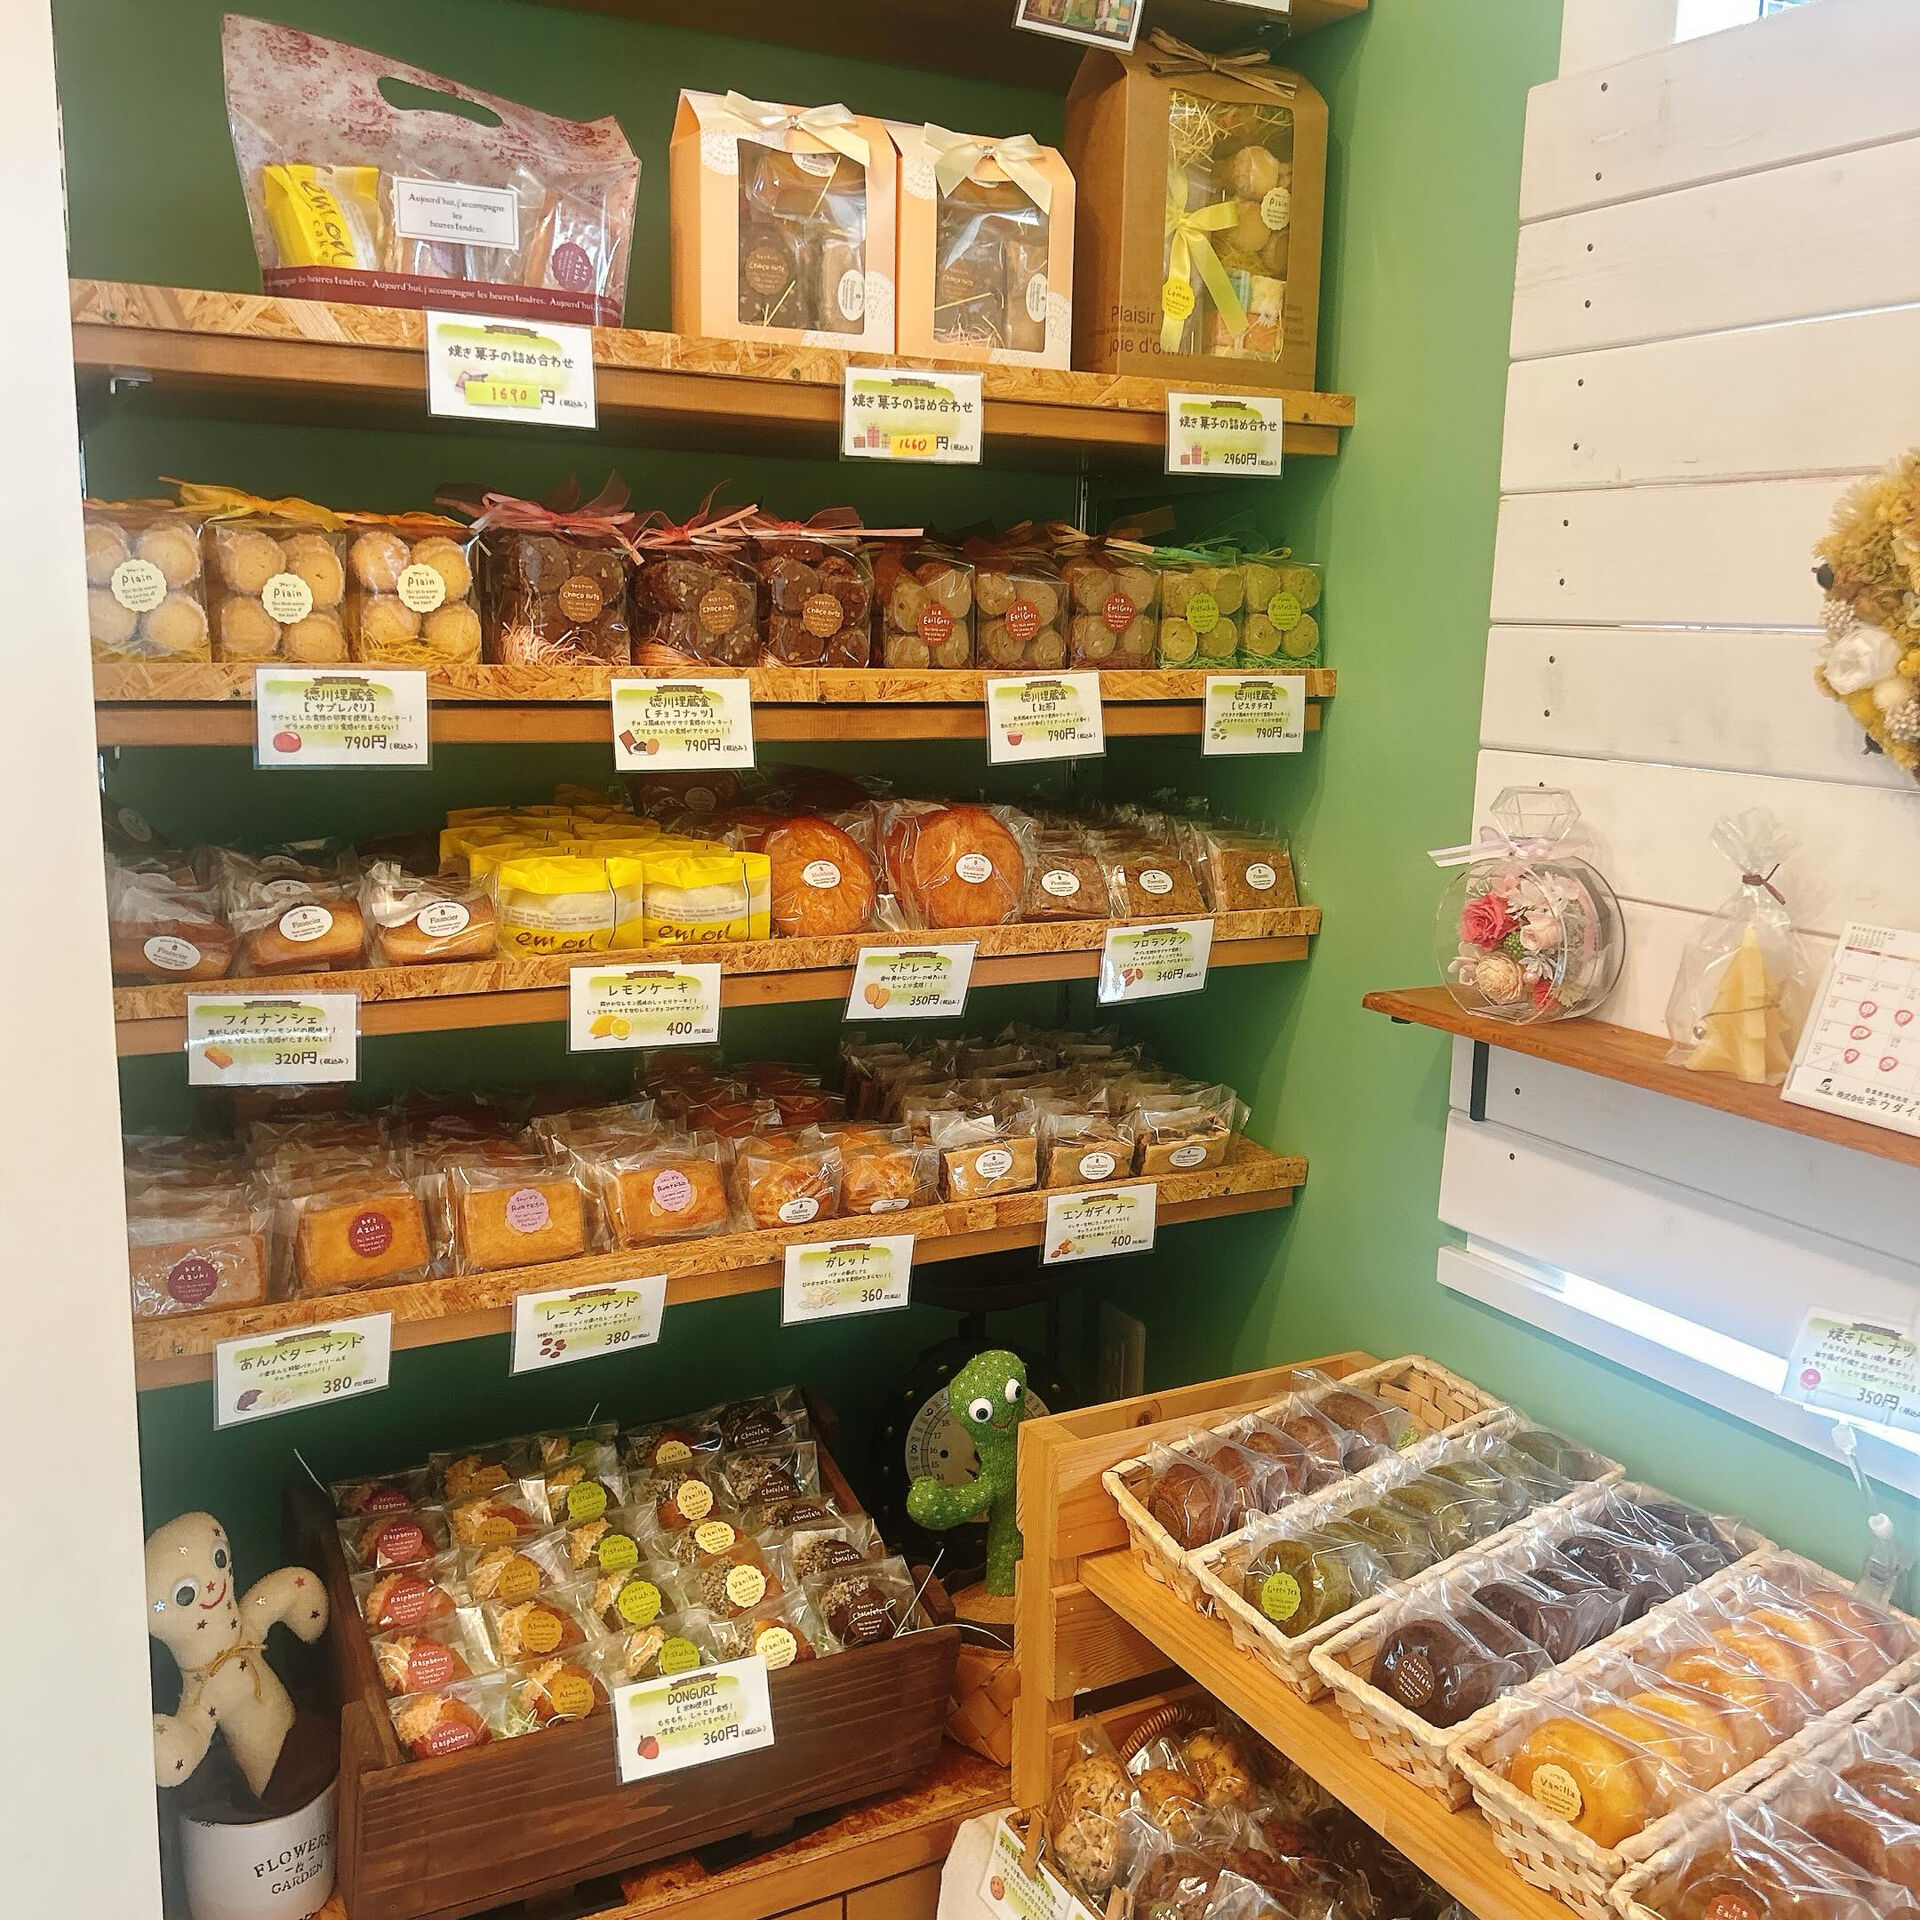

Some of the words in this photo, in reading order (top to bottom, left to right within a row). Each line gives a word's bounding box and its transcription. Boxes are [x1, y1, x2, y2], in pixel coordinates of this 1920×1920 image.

[452, 212, 462, 221] les
[429, 220, 459, 231] heures
[477, 289, 488, 299] les
[488, 291, 514, 302] heures
[1111, 305, 1157, 324] Plaisir
[1109, 337, 1134, 357] joie
[448, 345, 575, 369] 焼き菓子の詰め合わせ
[540, 388, 556, 405] 円
[852, 394, 974, 414] 焼き菓子の詰め合わせ
[1179, 415, 1278, 432] 焼き菓子の詰め合わせ
[936, 435, 949, 451] 円
[1223, 452, 1257, 467] 2960円
[121, 572, 154, 586] Plain
[407, 575, 435, 587] Plain
[273, 587, 302, 599] Plain
[303, 687, 378, 702] 徳川埋蔵金
[649, 694, 712, 708] 徳川埋蔵金
[1047, 727, 1076, 742] 790円
[1256, 726, 1283, 739] 790円
[344, 734, 387, 750] 790円
[684, 737, 721, 753] 790円
[1132, 936, 1186, 949] フロランタン
[888, 962, 943, 973] マドレーヌ
[1156, 968, 1184, 981] 340円
[608, 981, 689, 997] レモンケーキ
[909, 994, 940, 1006] 350円
[223, 1012, 318, 1026] フィナンシェ
[666, 1021, 693, 1036] 400
[273, 1051, 317, 1066] 320円
[1063, 1202, 1135, 1221] エンガディナー
[356, 1224, 385, 1235] Azuki
[1110, 1235, 1132, 1248] 400
[825, 1254, 870, 1269] ガレット
[177, 1271, 209, 1281] Azuki
[860, 1288, 883, 1303] 360
[546, 1295, 638, 1321] レーズンサンド
[604, 1330, 630, 1346] 380
[1827, 1327, 1917, 1358] 焼きドーナツ
[239, 1334, 365, 1371] あんバターサンド
[322, 1376, 352, 1394] 380
[1856, 1387, 1900, 1411] 350円
[741, 1426, 771, 1441] Chocolate
[661, 1449, 687, 1462] Vanilla
[681, 1490, 708, 1502] Vanilla
[760, 1484, 790, 1497] Chocolate
[372, 1500, 407, 1511] Raspberry
[792, 1510, 821, 1522] Chocolate
[383, 1530, 419, 1542] Raspberry
[700, 1528, 728, 1540] Vanilla
[831, 1553, 861, 1565] Chocolate
[731, 1575, 759, 1589] Vanilla
[390, 1590, 426, 1605] Raspberry
[852, 1607, 883, 1620] Chocolate
[761, 1637, 790, 1651] Vanilla
[411, 1654, 449, 1669] Raspberry
[1401, 1659, 1432, 1691] Chocolate
[667, 1684, 719, 1707] DONGURI
[431, 1732, 470, 1750] Raspberry
[702, 1723, 739, 1746] 360円
[1540, 1777, 1576, 1799] Vanilla
[253, 1831, 334, 1878] FLOWERS
[271, 1859, 324, 1895] GARDEN
